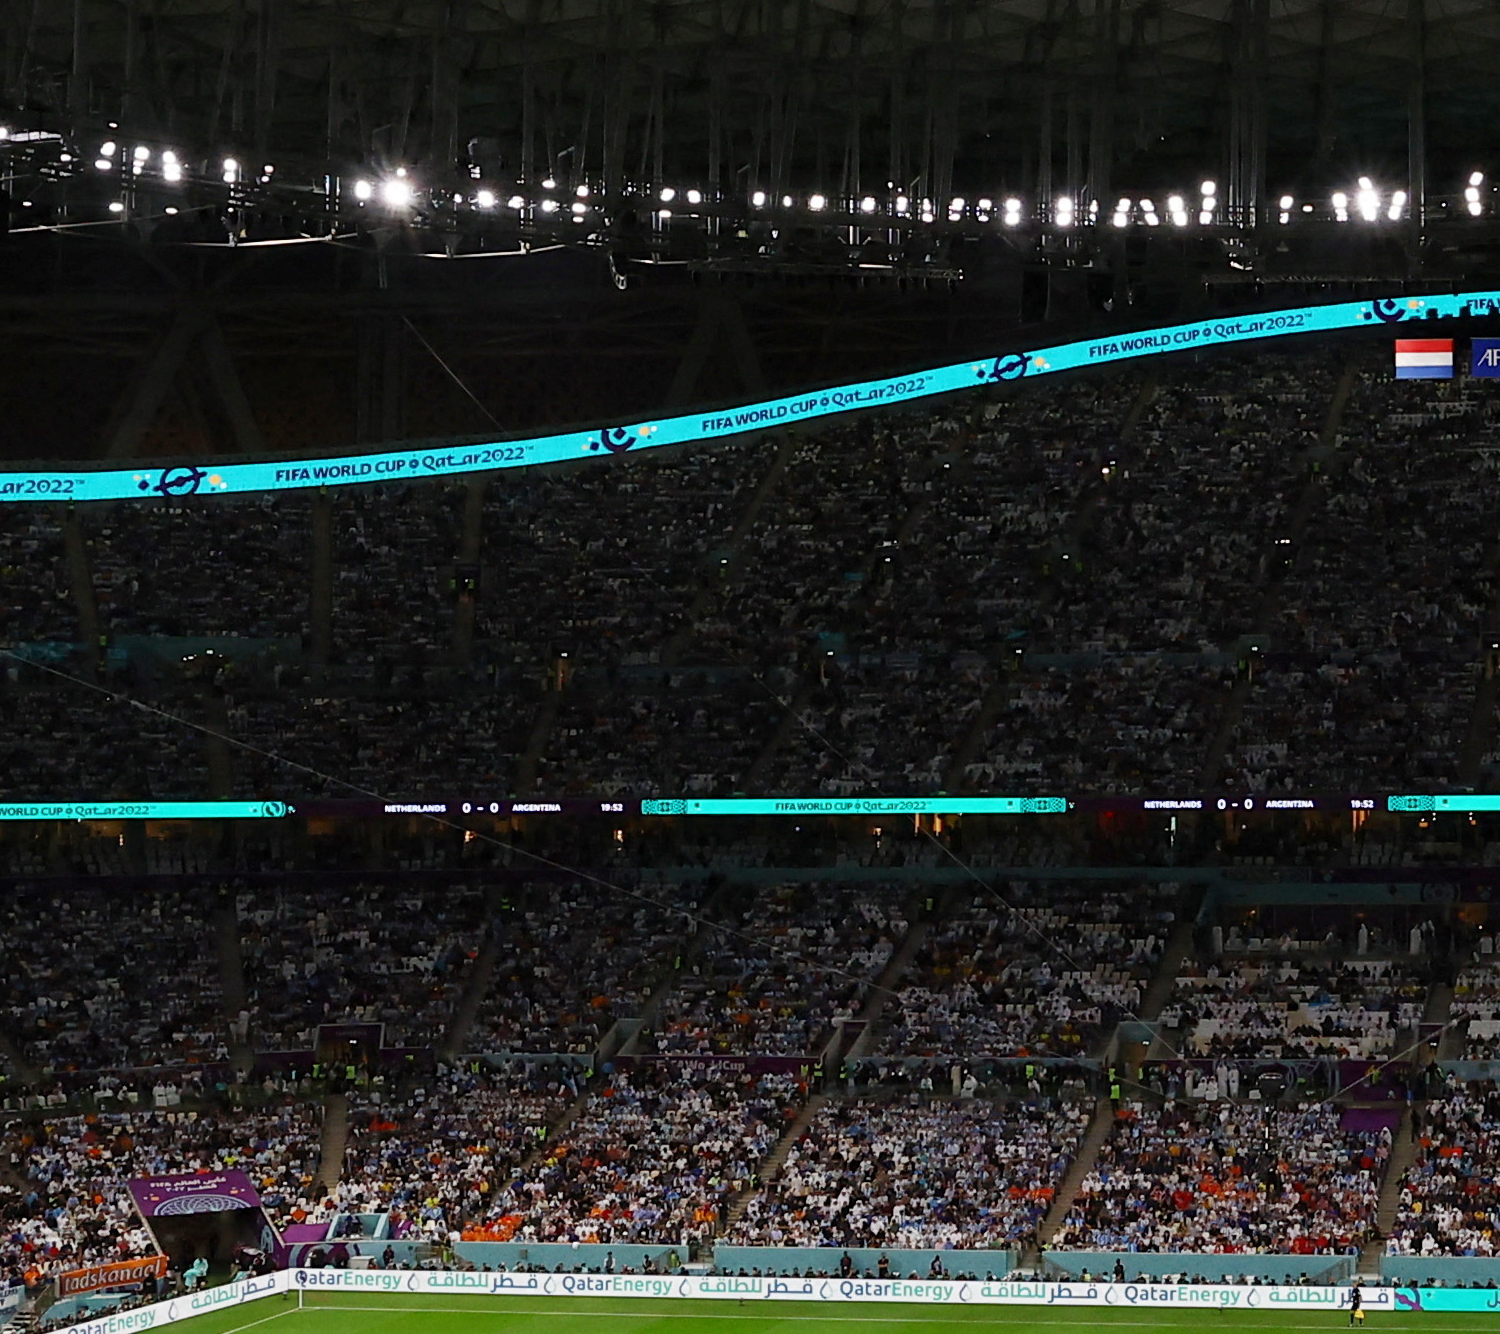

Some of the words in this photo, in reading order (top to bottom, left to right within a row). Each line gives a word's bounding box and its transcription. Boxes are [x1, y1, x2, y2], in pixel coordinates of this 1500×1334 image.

[703, 417, 733, 431] FIFA
[736, 406, 787, 425] WORLD
[790, 399, 817, 414] CUP
[239, 1274, 274, 1299] قطر
[295, 1270, 401, 1289] QatarEnergy
[428, 1273, 488, 1287] للطاقة
[489, 1274, 537, 1293] قطر
[563, 1276, 671, 1295] QatarEnergy
[192, 1285, 237, 1309] للطاقة
[1125, 1286, 1240, 1305] QatarEnergy
